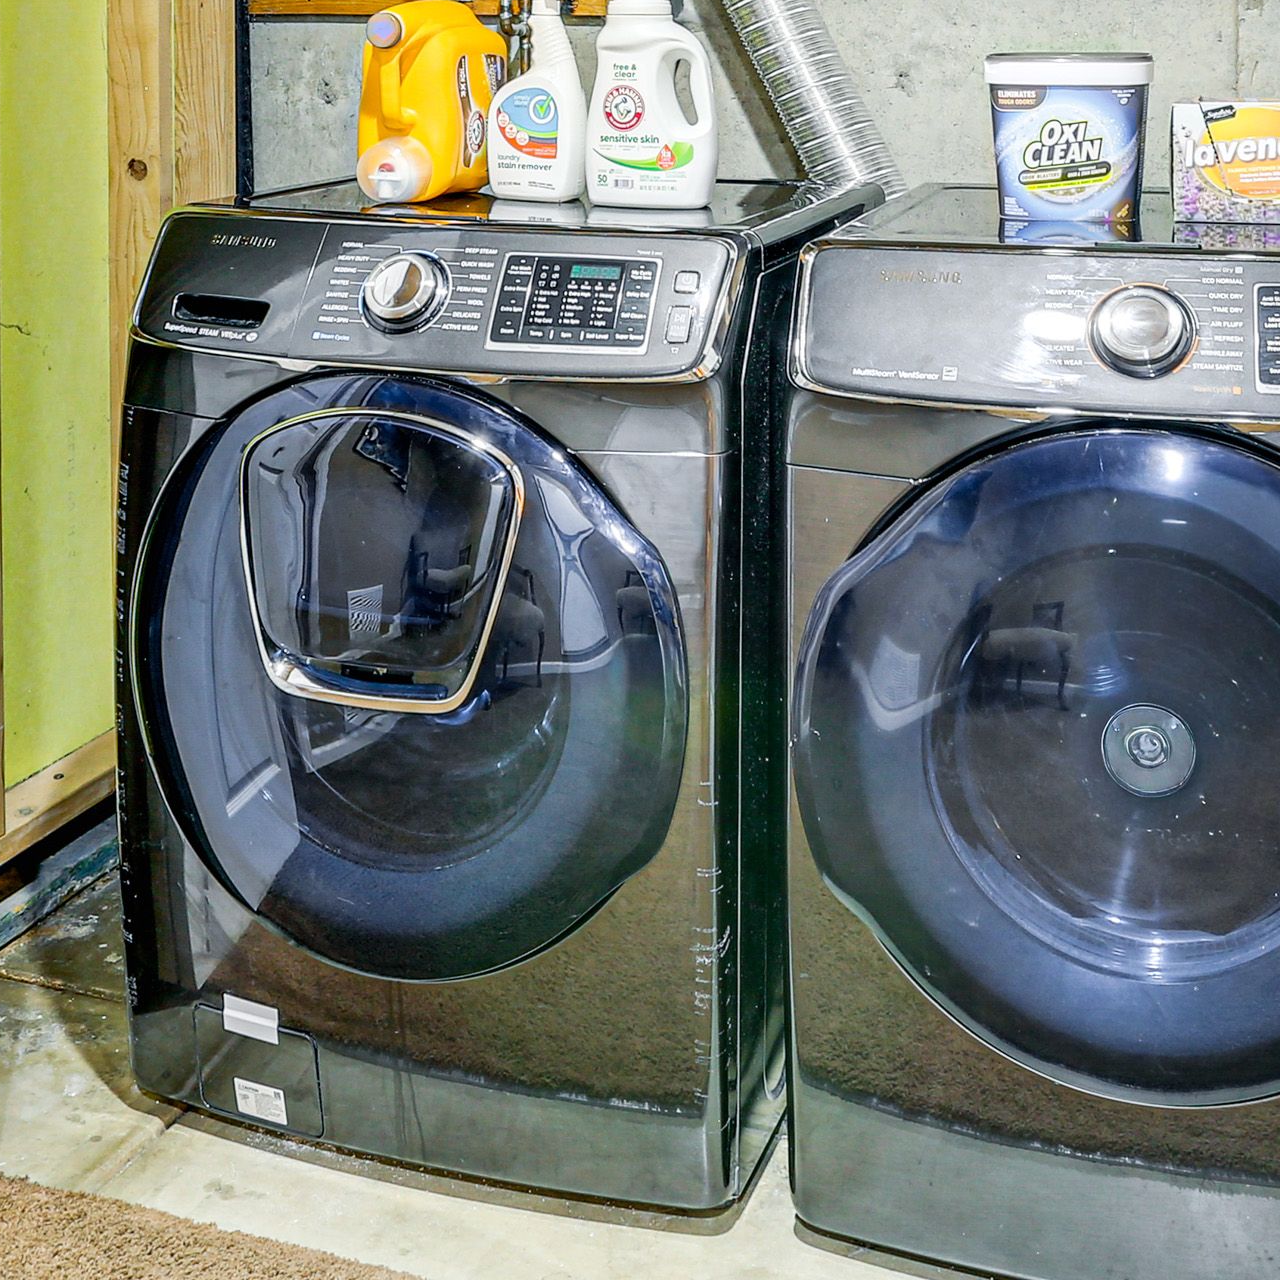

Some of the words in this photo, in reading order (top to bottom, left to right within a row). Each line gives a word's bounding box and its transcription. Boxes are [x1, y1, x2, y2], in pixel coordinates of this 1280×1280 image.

[998, 90, 1037, 98] ELIMINATES
[619, 87, 643, 113] HAMMER
[1040, 119, 1088, 146] OXI
[601, 134, 639, 143] sensitive
[641, 134, 660, 143] skin
[1024, 138, 1103, 169] CLEAN
[498, 154, 520, 162] laundry
[518, 163, 553, 171] remover
[598, 174, 608, 183] 50
[334, 266, 357, 274] BEDDING
[626, 291, 639, 299] Delay
[452, 311, 481, 319] DELICATES
[164, 322, 198, 335] SuperSpeed
[198, 327, 219, 337] STEAM
[442, 323, 462, 331] ACTIVE
[561, 331, 572, 339] Spin
[615, 333, 629, 341] Super
[629, 334, 644, 342] Speed
[1215, 363, 1244, 371] SANITIZE
[898, 370, 940, 381] VentSensor
